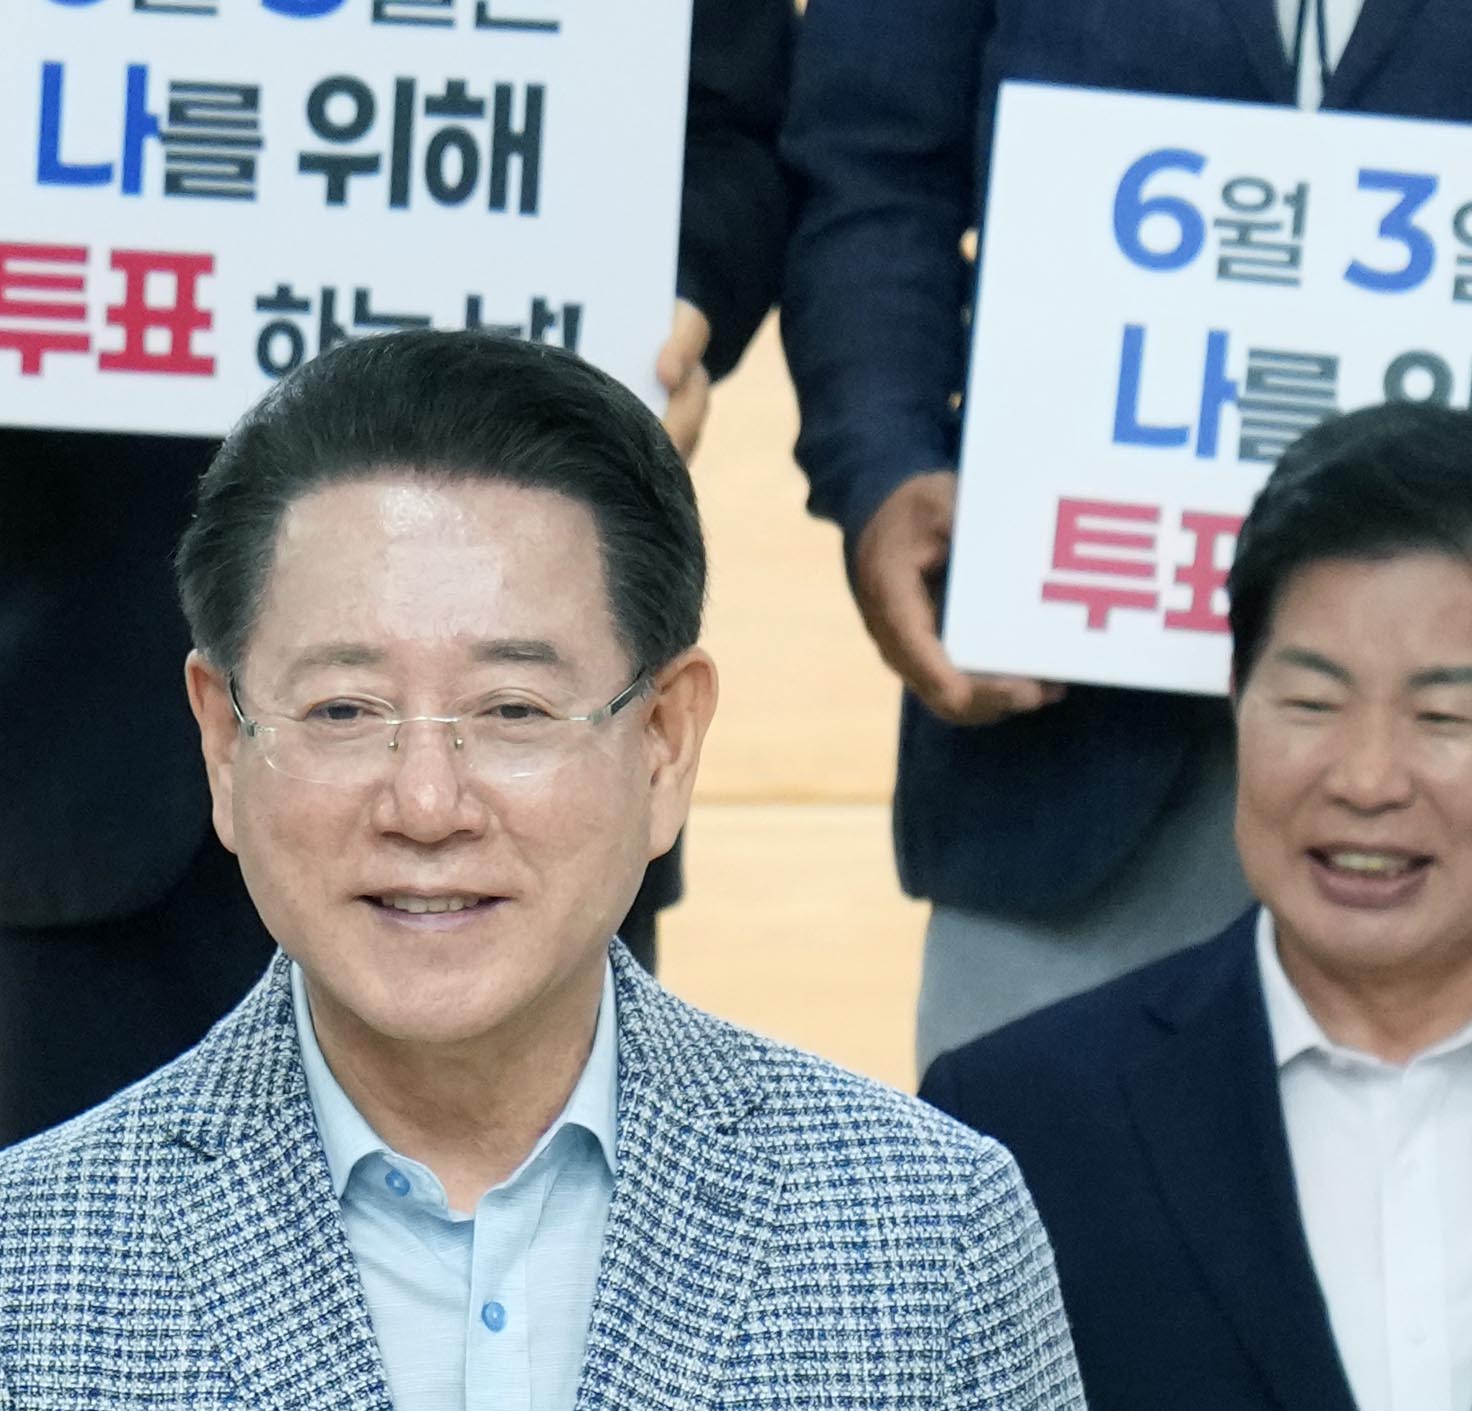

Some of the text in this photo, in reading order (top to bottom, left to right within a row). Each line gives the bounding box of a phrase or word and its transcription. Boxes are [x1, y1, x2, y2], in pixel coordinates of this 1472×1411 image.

[36, 61, 546, 217] 나를 위해
[1112, 148, 1309, 287] 6월
[1112, 323, 1338, 464] 나를
